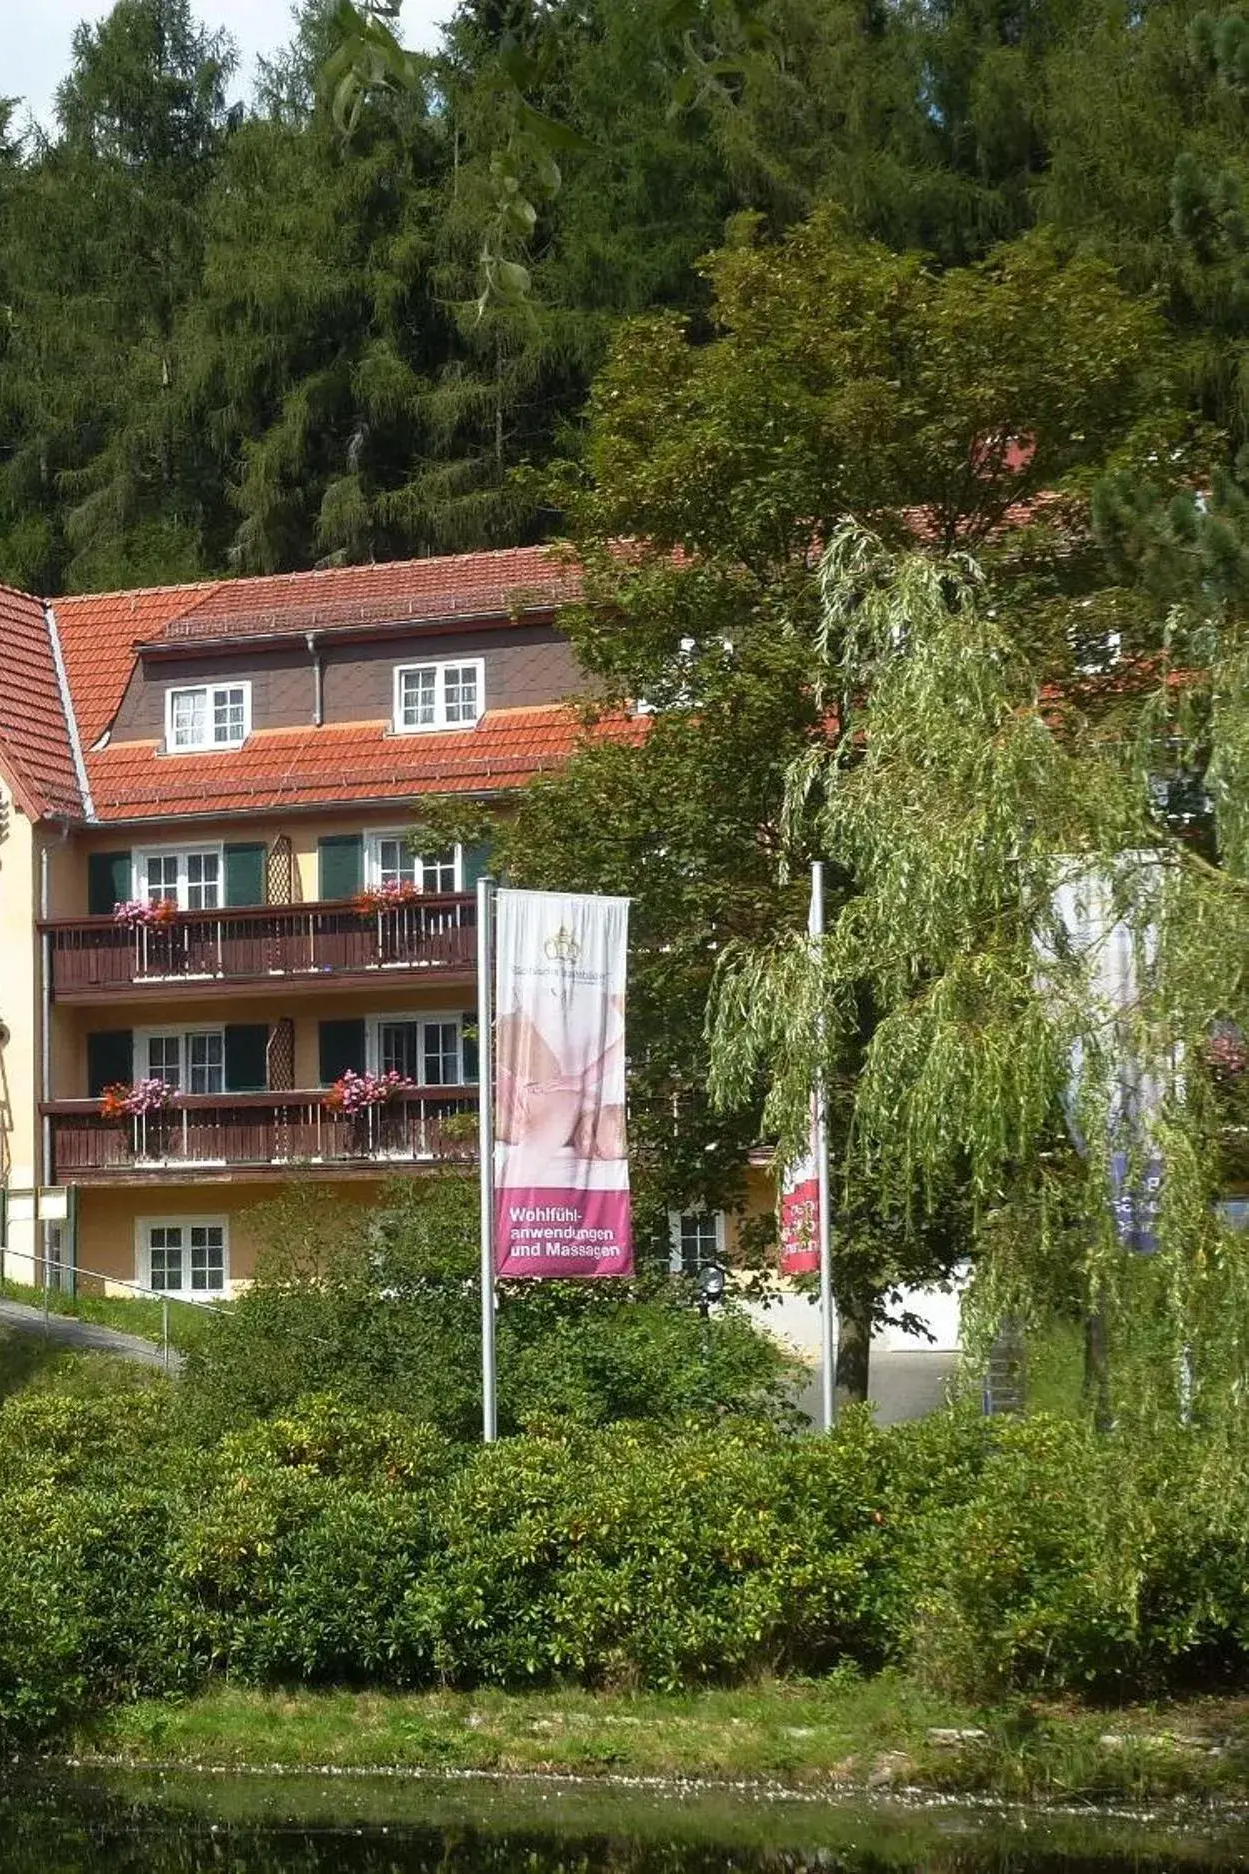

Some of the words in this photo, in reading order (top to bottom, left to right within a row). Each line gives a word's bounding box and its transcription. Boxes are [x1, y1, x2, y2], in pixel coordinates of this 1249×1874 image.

[509, 1207, 583, 1222] Wohlfühl-
[510, 1226, 614, 1242] anwendungen
[510, 1242, 541, 1257] und
[545, 1242, 621, 1260] Massagen
